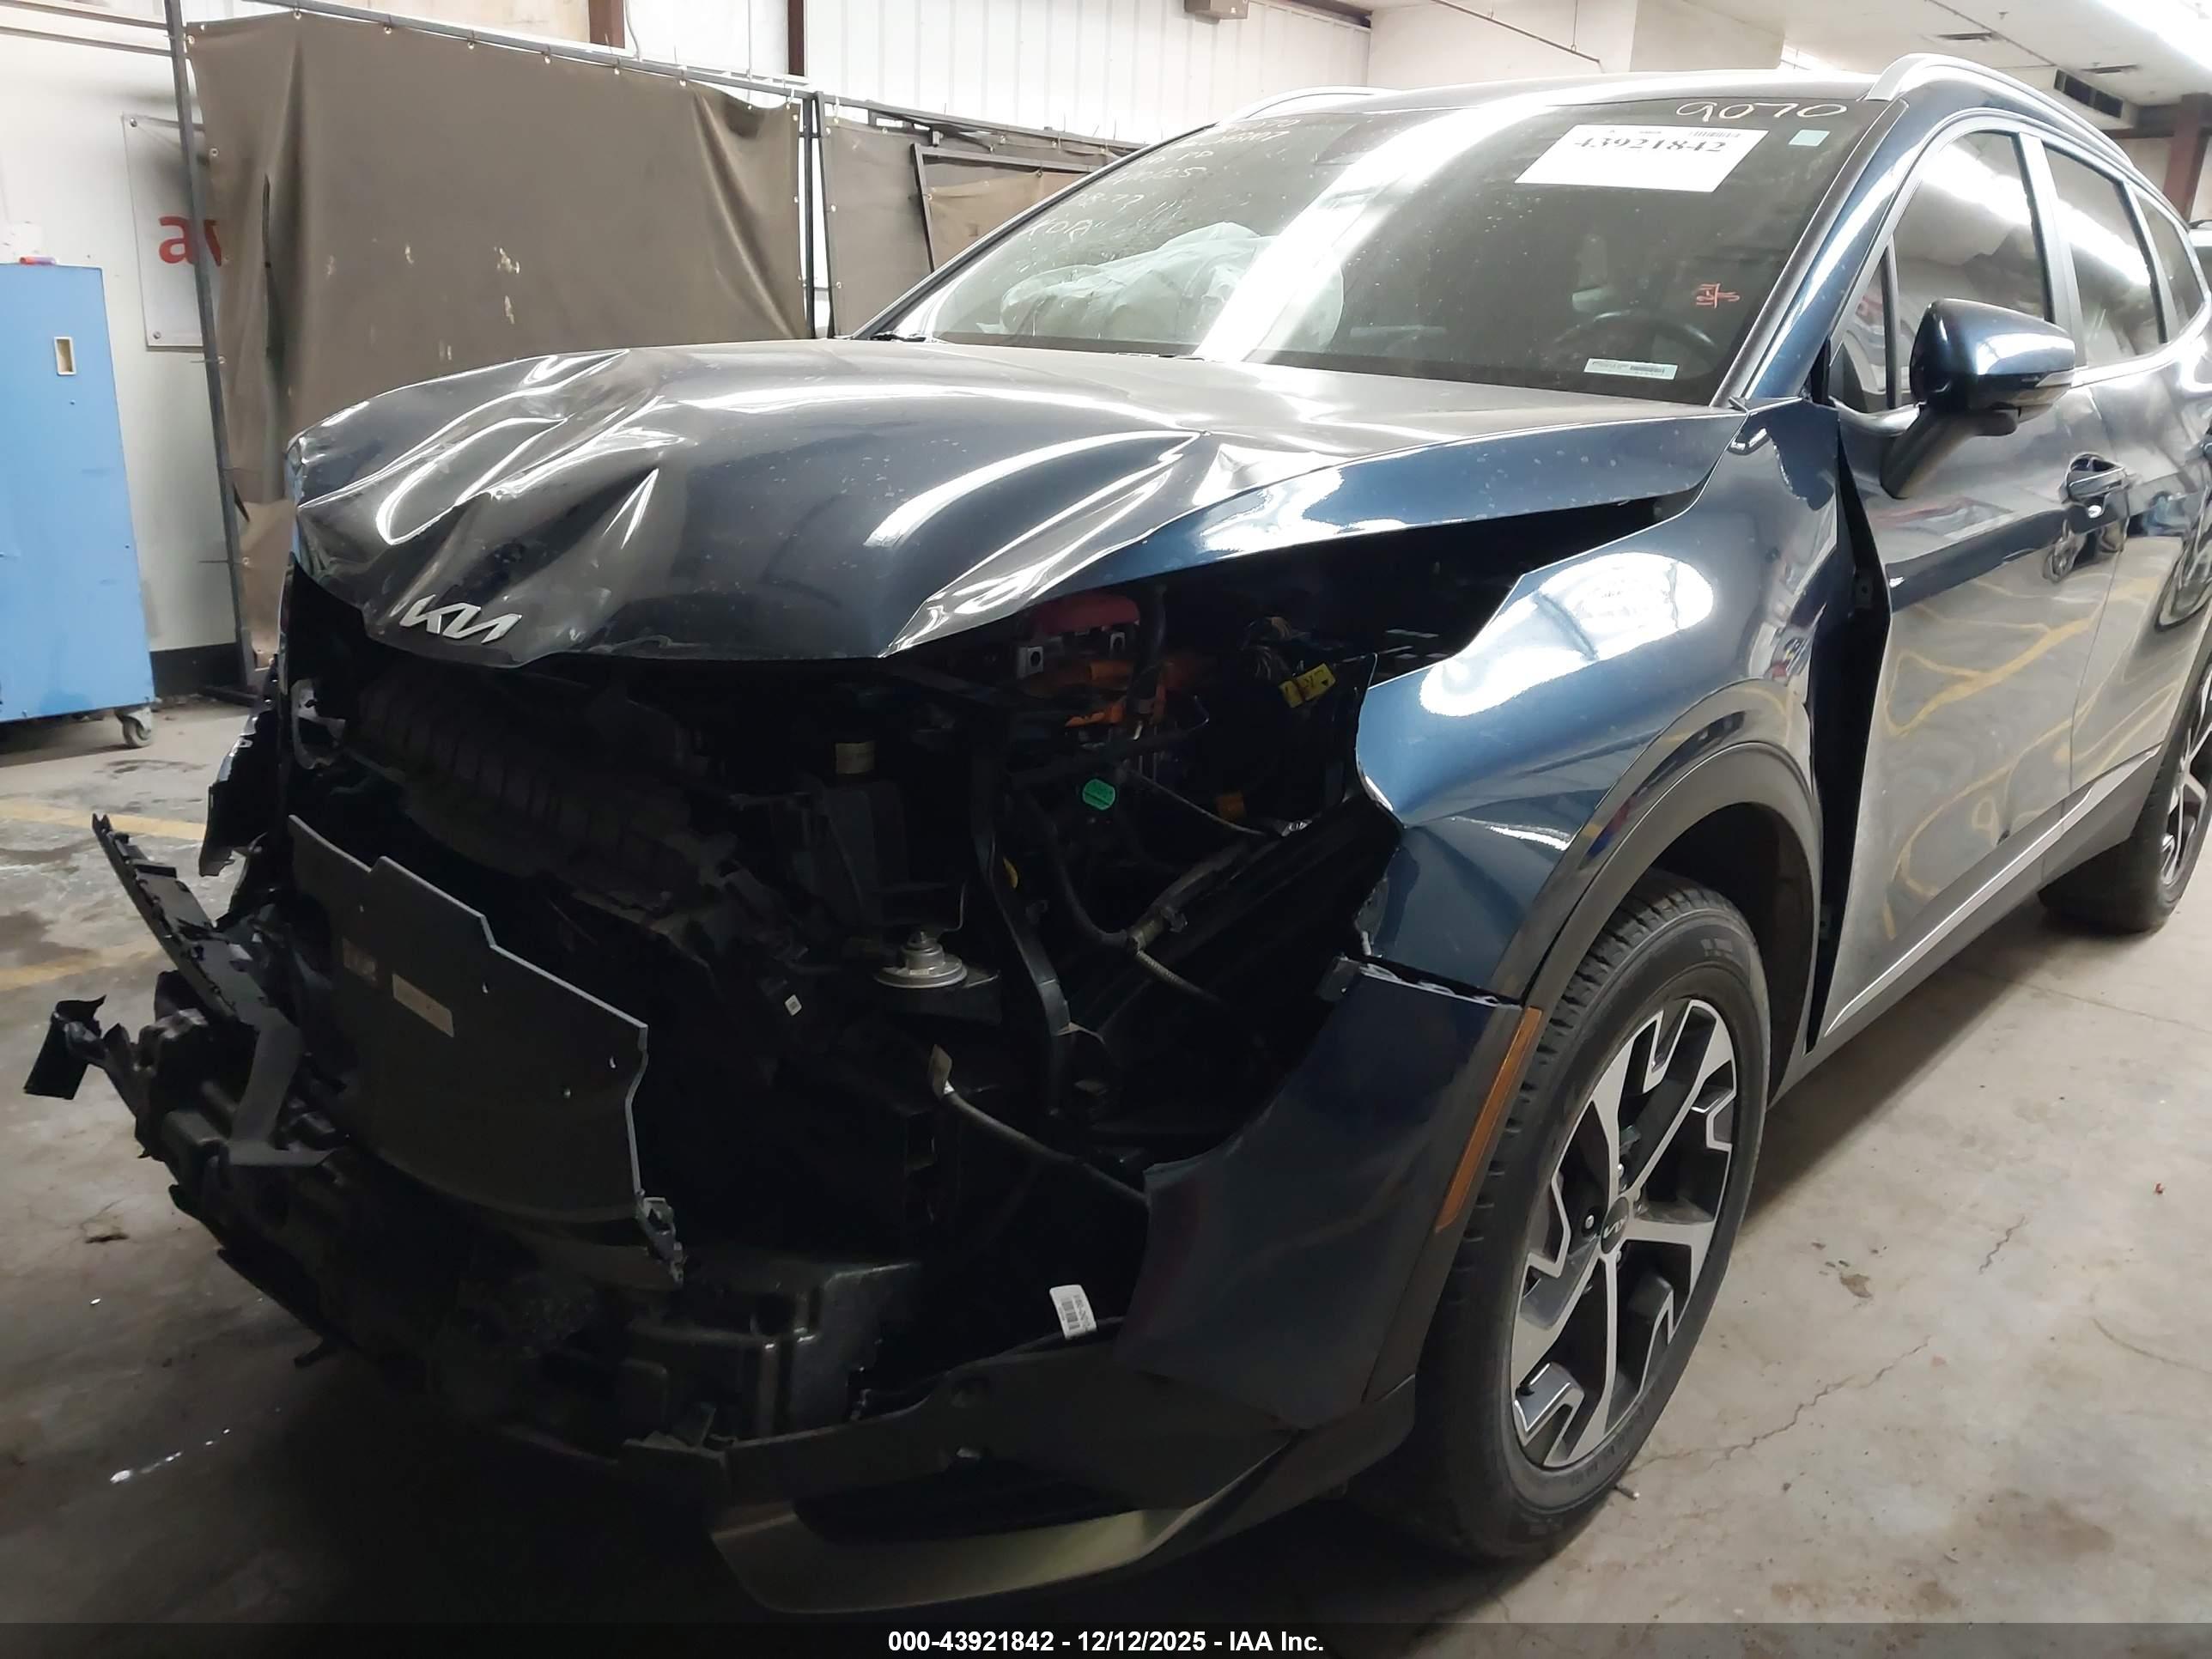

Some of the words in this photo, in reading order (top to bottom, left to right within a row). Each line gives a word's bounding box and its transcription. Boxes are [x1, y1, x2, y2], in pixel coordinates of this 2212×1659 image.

[1676, 101, 1848, 123] 9070
[1573, 136, 1727, 153] 43921842
[399, 594, 523, 645] KIA
